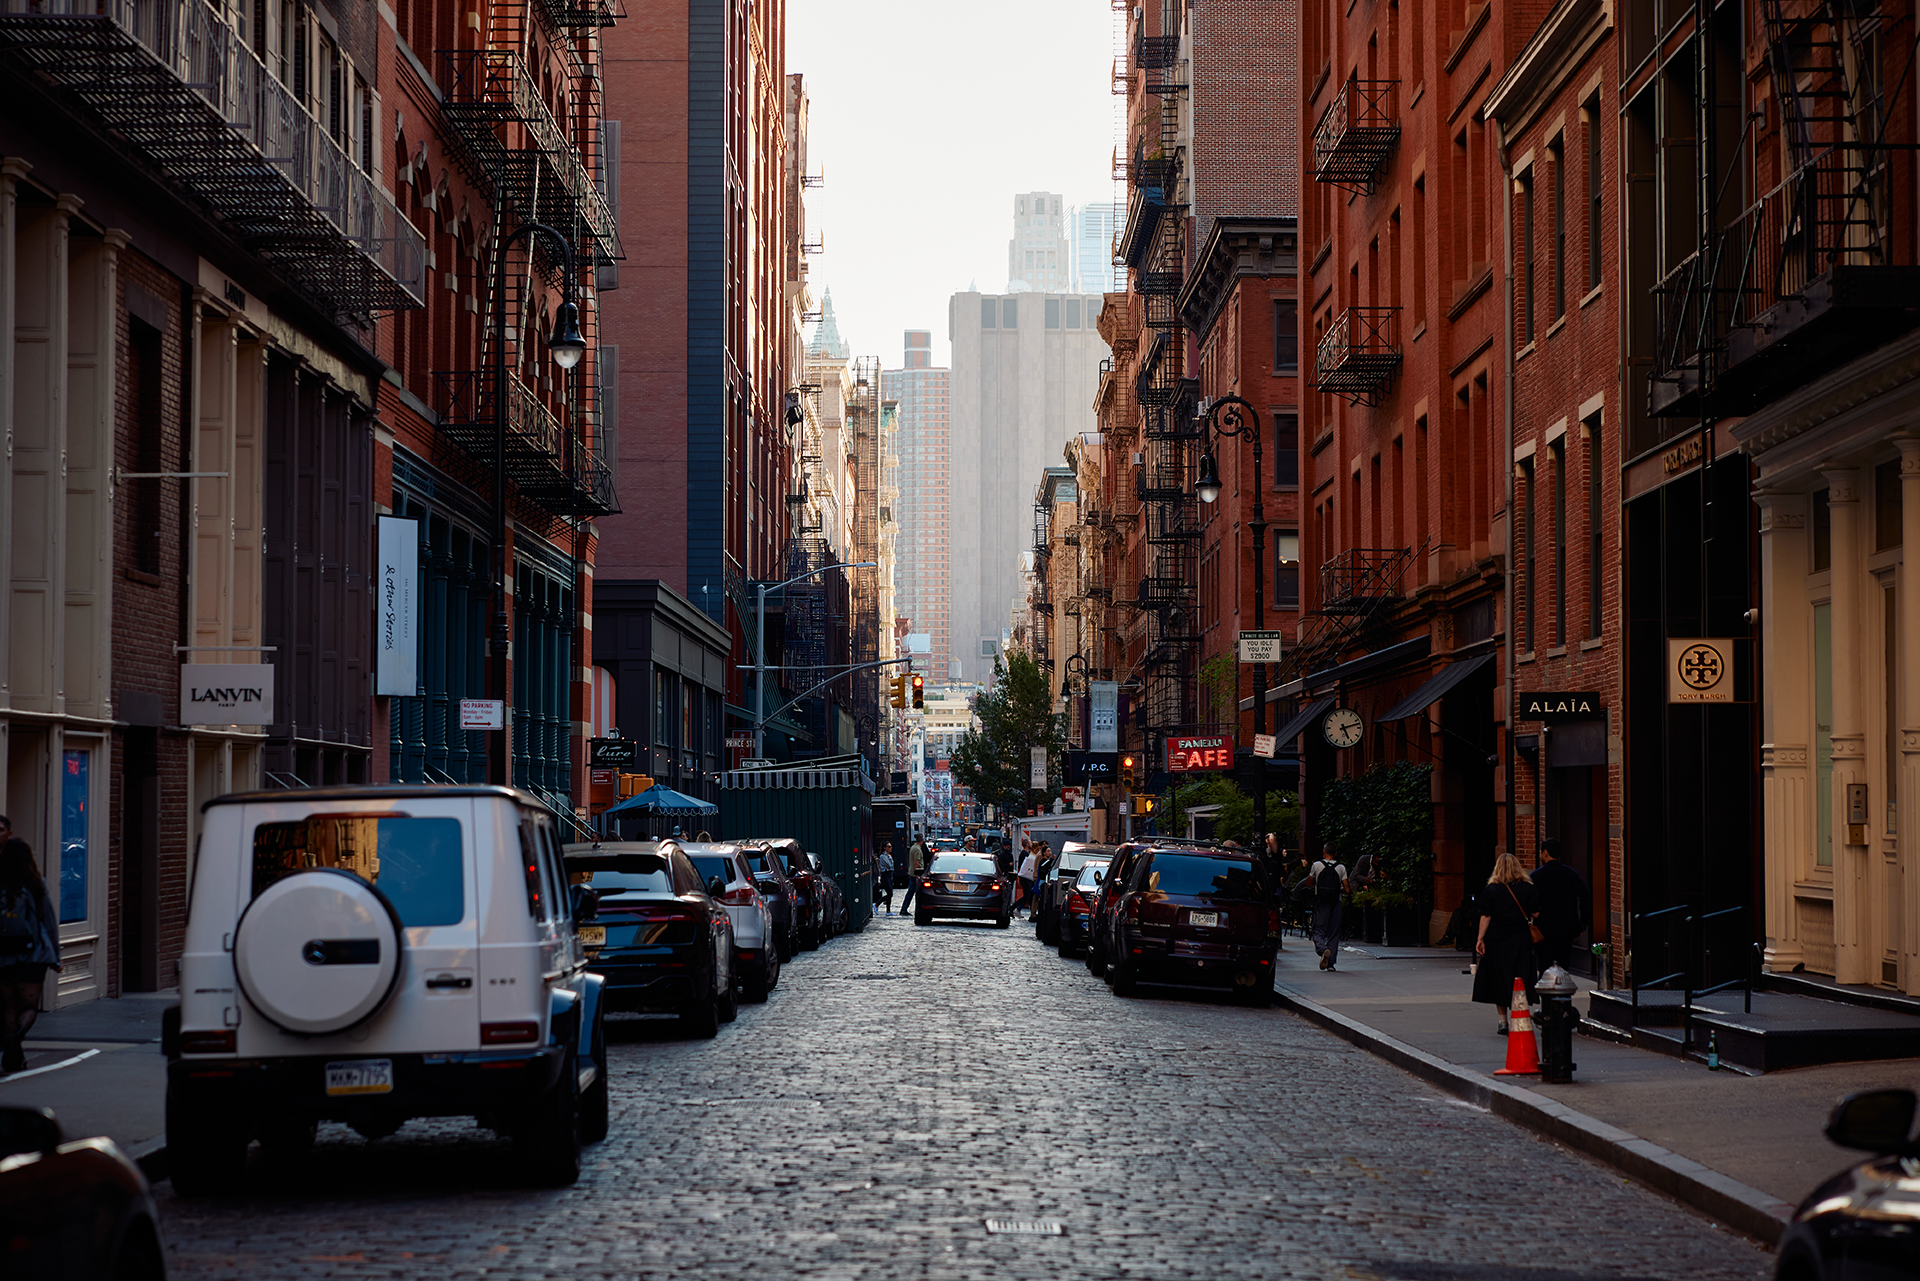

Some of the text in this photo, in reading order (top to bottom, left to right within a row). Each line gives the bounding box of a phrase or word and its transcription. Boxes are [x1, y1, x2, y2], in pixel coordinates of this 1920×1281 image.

[385, 564, 396, 576] &
[385, 612, 396, 651] Stories
[191, 688, 262, 702] LANVIN
[1529, 698, 1591, 713] ALAÏA
[726, 739, 753, 748] PRINCE ST
[1178, 739, 1223, 749] FANELLI
[1176, 749, 1228, 768] AFE
